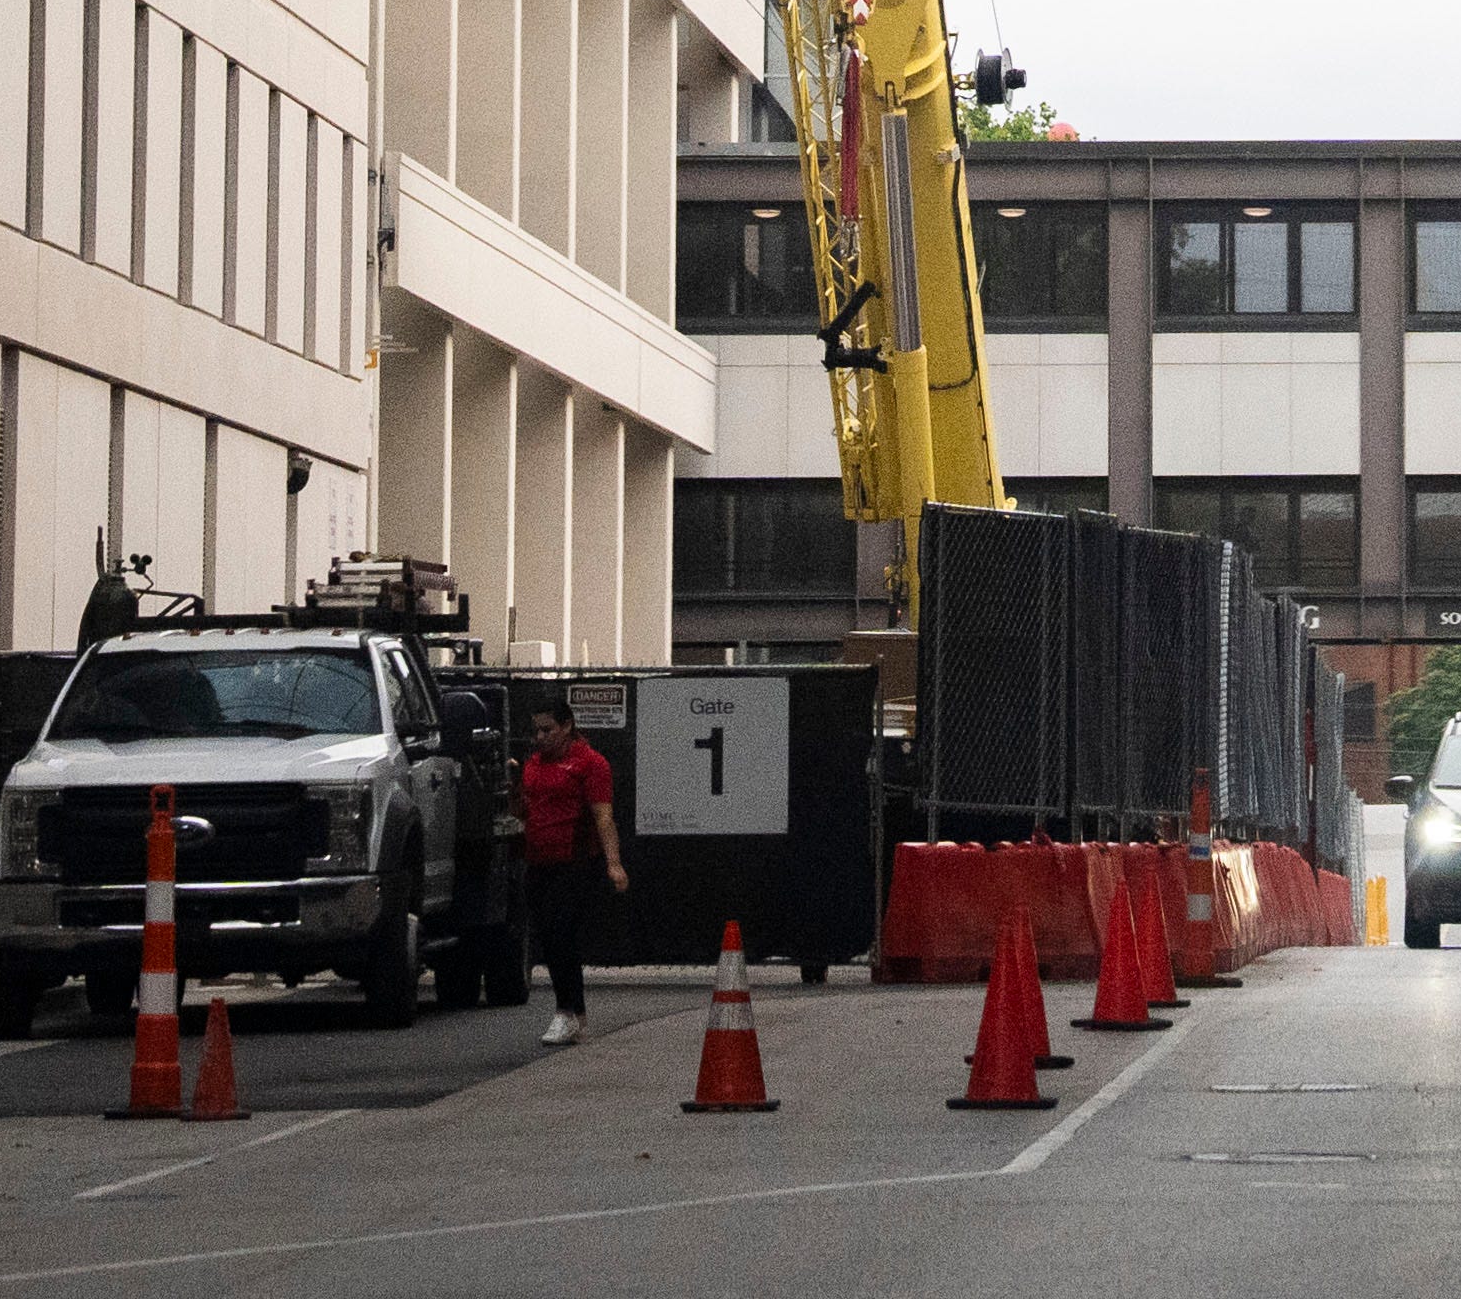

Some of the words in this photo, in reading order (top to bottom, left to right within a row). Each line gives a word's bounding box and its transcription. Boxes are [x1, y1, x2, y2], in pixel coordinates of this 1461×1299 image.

[575, 689, 619, 702] DANGER
[689, 697, 735, 715] Gate
[694, 726, 724, 796] 1
